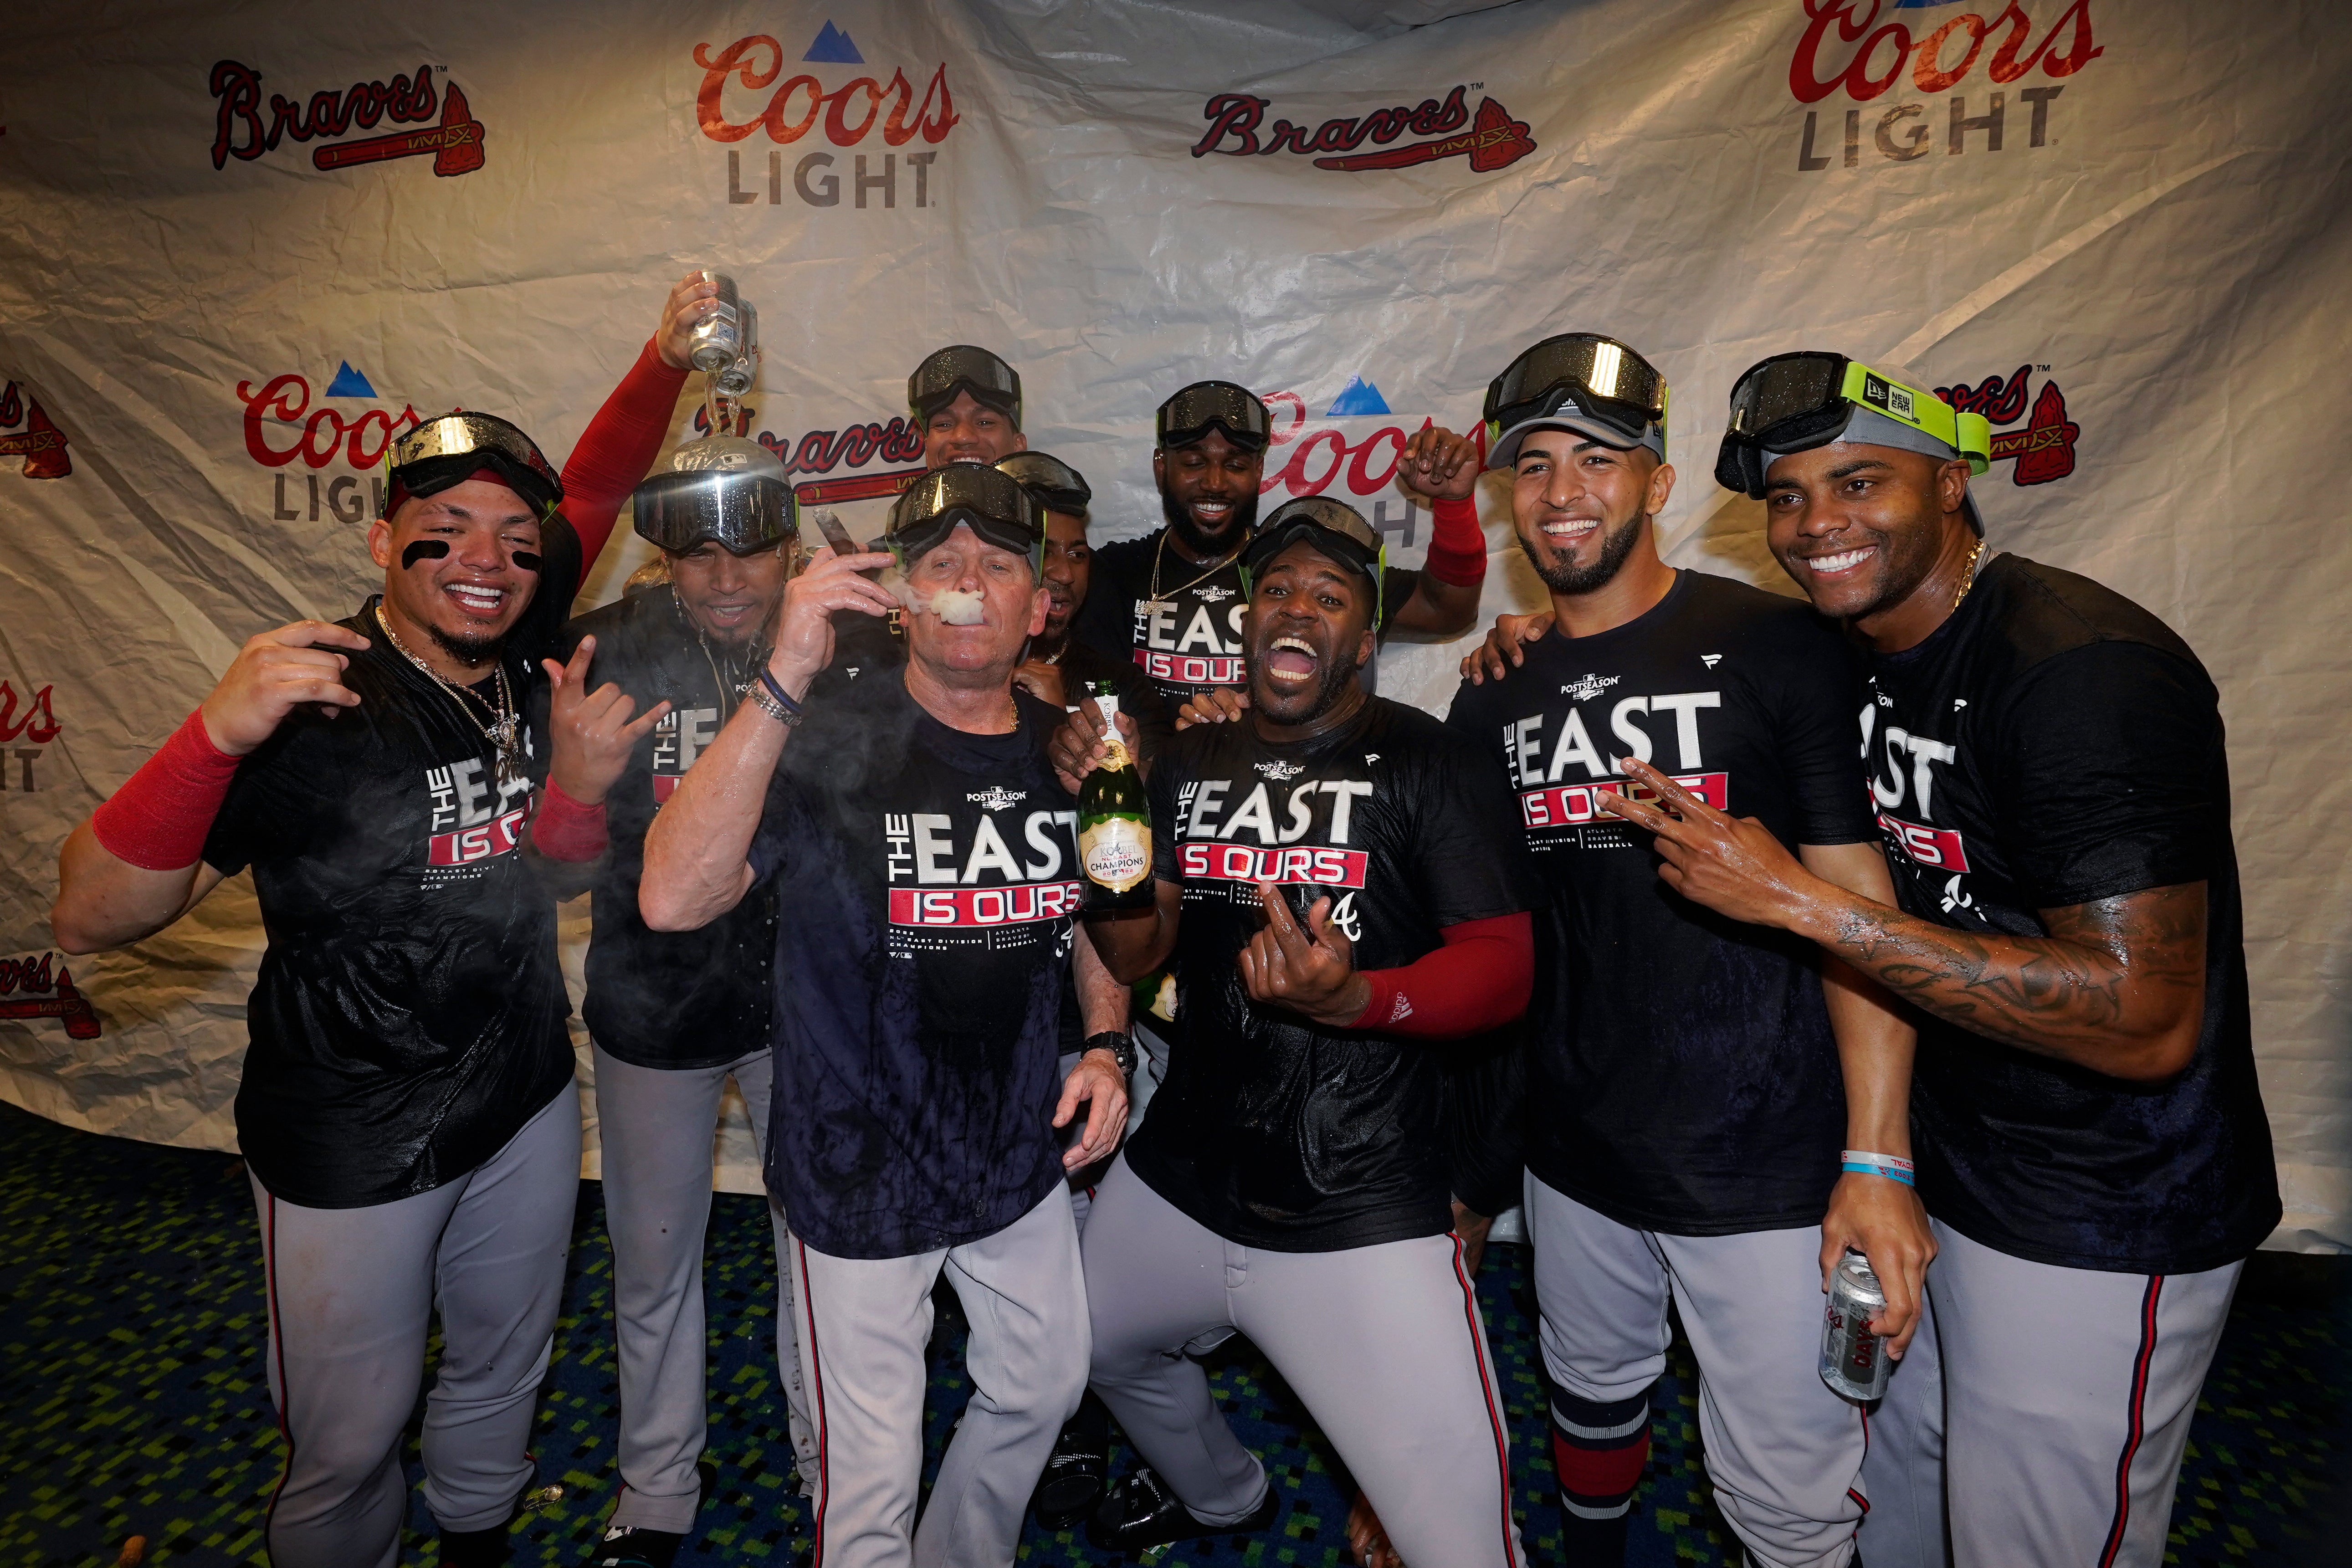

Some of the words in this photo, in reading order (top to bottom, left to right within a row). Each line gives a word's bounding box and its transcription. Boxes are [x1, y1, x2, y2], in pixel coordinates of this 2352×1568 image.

[1788, 0, 2105, 103] Coors
[693, 34, 960, 147] Coors
[210, 59, 437, 171] Braves
[1191, 85, 1469, 159] Braves
[1798, 85, 2066, 172] LIGHT
[729, 149, 937, 209] LIGHT
[1891, 400, 1910, 414] ERA
[1892, 391, 1910, 405] NEW
[236, 374, 462, 471] Coo
[274, 474, 384, 523] LIG
[1148, 602, 1250, 655] EAS
[1146, 653, 1173, 678] IS
[1184, 659, 1247, 682] OUR
[1561, 676, 1619, 694] POSTSEASON
[1517, 691, 1722, 787] EAST
[1859, 703, 1956, 821] ST
[1254, 763, 1304, 775] POSTSEASON
[426, 766, 456, 832] THE
[966, 792, 1026, 802] POSTSEASON
[1174, 781, 1199, 841] THE
[1186, 779, 1373, 845] EAST
[1522, 792, 1550, 826] IS
[451, 826, 492, 862] IS
[885, 813, 913, 882] THE
[912, 810, 1081, 884] EAST
[1091, 857, 1143, 871] CHAMPIONS
[1184, 845, 1209, 874] S
[1223, 846, 1348, 883] OURS
[423, 873, 482, 881] CHAMPIONS
[913, 892, 958, 924] IS
[973, 882, 1080, 924] OURS
[995, 927, 1030, 935] ATLANTA
[996, 938, 1038, 950] BASEBALL
[1389, 991, 1404, 1024] adidas
[1854, 1320, 1874, 1368] DAYS
